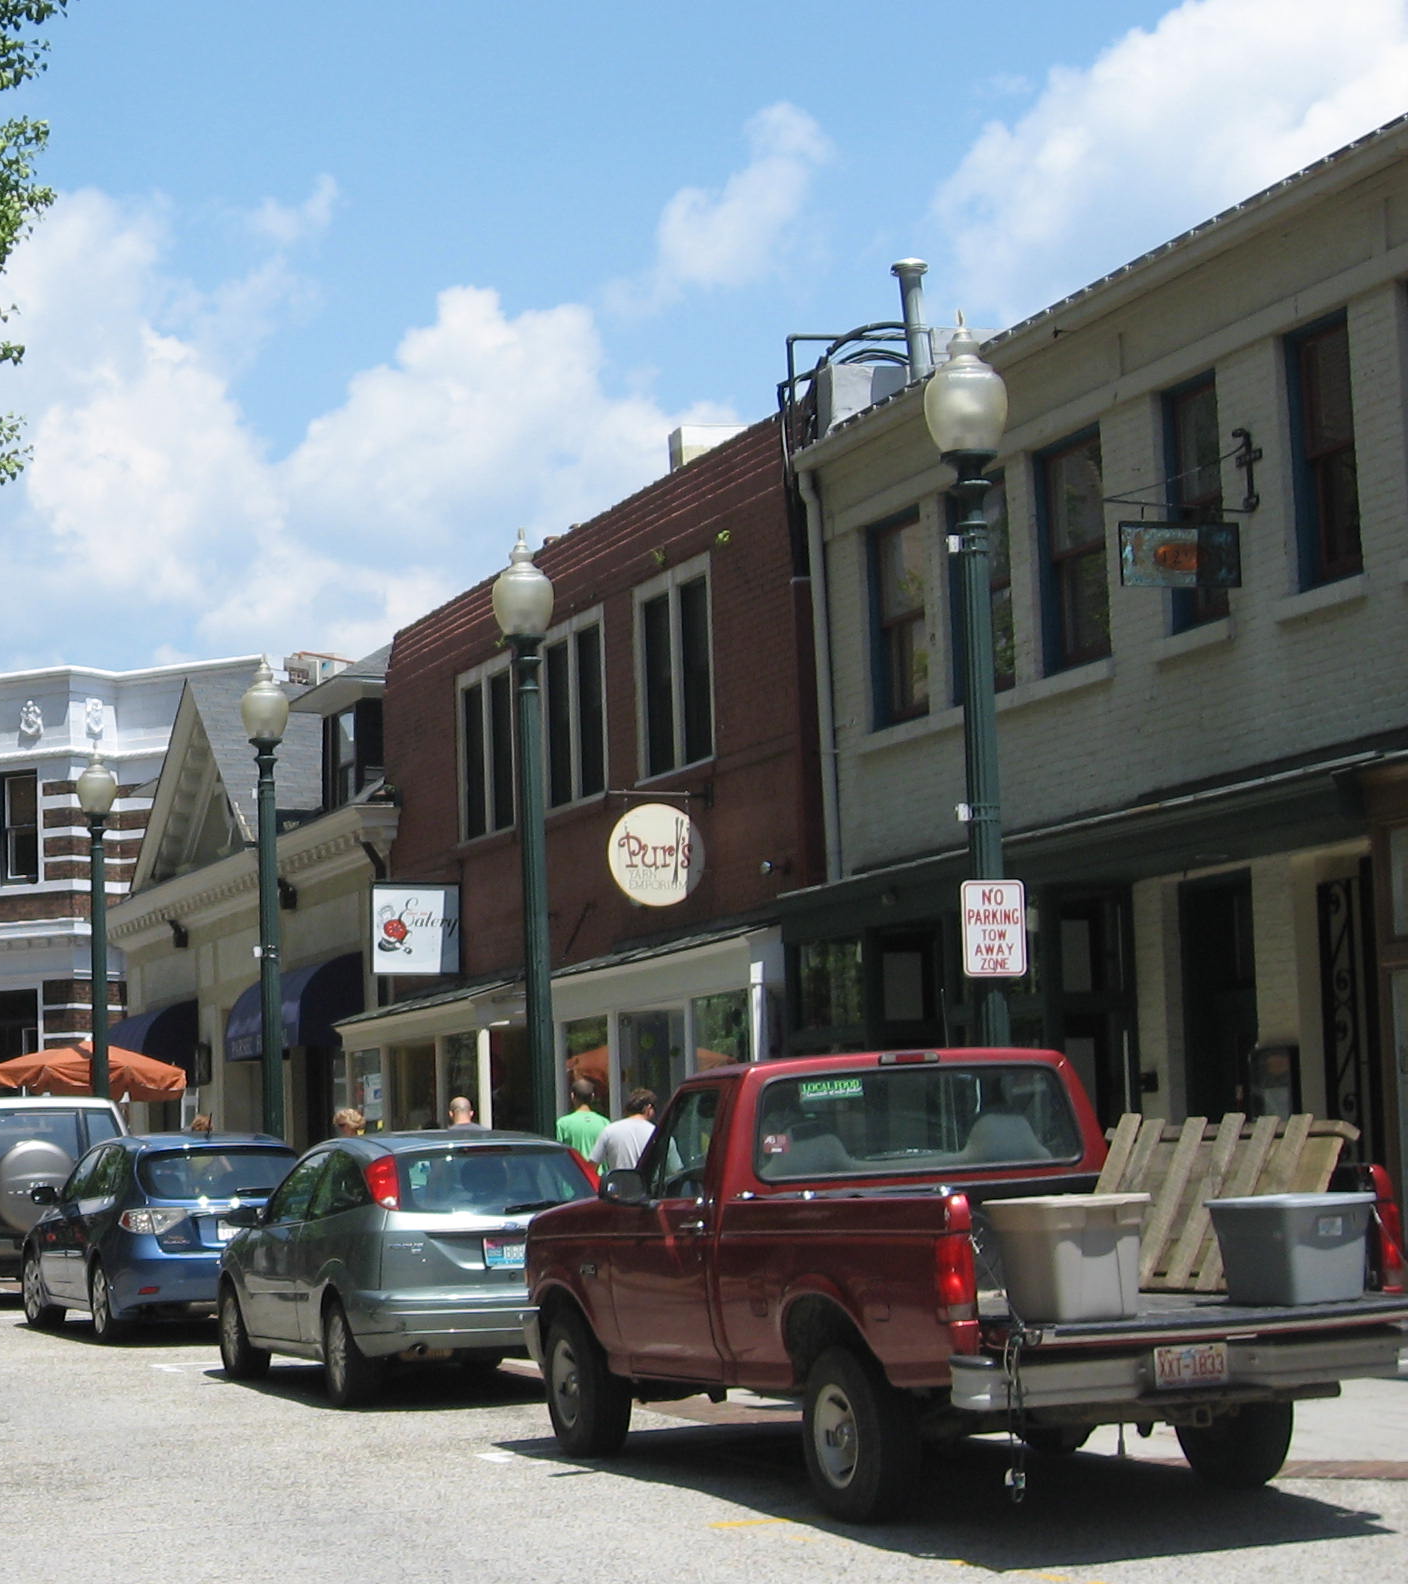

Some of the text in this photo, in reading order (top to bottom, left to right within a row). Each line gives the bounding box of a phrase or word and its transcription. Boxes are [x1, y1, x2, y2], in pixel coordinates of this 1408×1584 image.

[629, 868, 657, 879] YARN
[982, 888, 1005, 906] NO
[398, 897, 458, 938] Eatery
[968, 908, 1019, 925] PARKING
[982, 928, 1007, 941] TOW
[975, 943, 1014, 956] AWAY
[980, 957, 1010, 970] ZONE
[802, 1081, 831, 1093] LOCAL
[834, 1080, 860, 1089] FOOD
